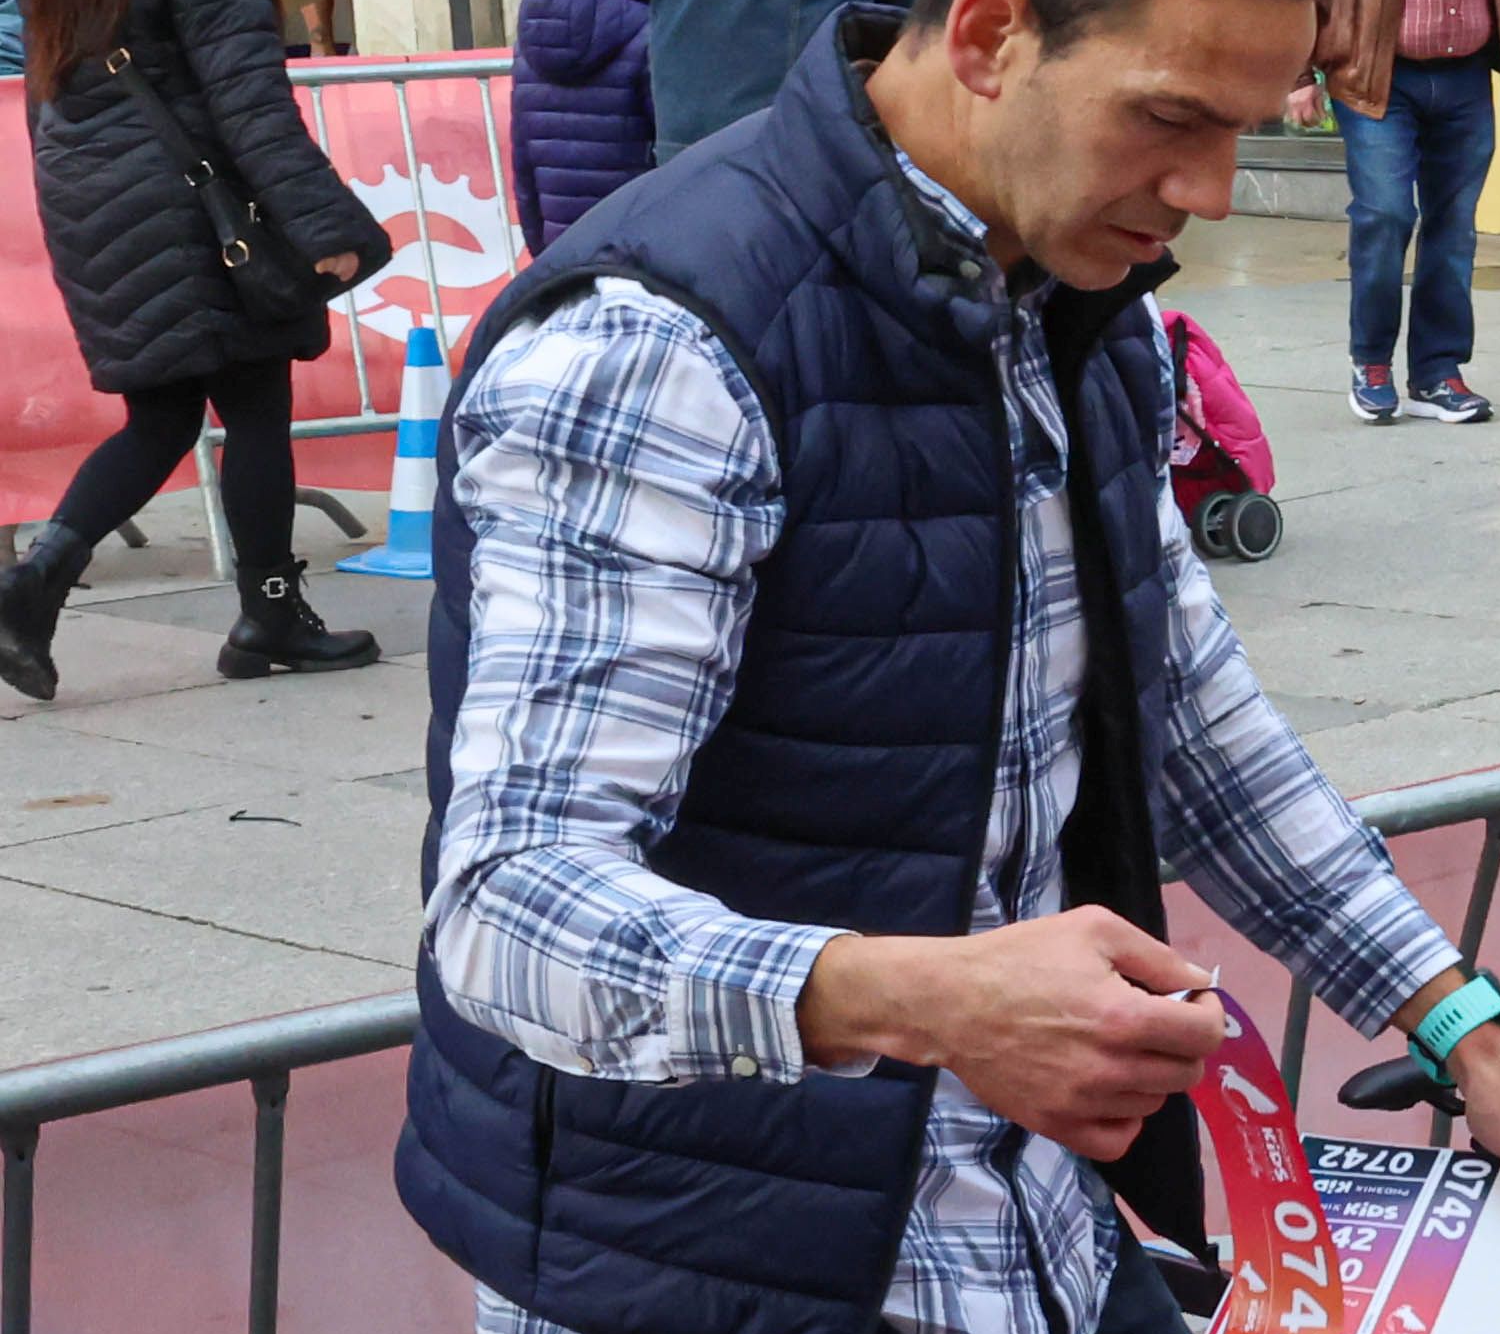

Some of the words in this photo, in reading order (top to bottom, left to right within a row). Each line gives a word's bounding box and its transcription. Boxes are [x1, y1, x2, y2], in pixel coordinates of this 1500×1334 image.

[1318, 1144, 1414, 1175] 0742
[1312, 1179, 1353, 1195] KiD
[1421, 1158, 1493, 1241] 0742
[1343, 1201, 1399, 1221] KiDS
[1332, 1225, 1377, 1252] 42
